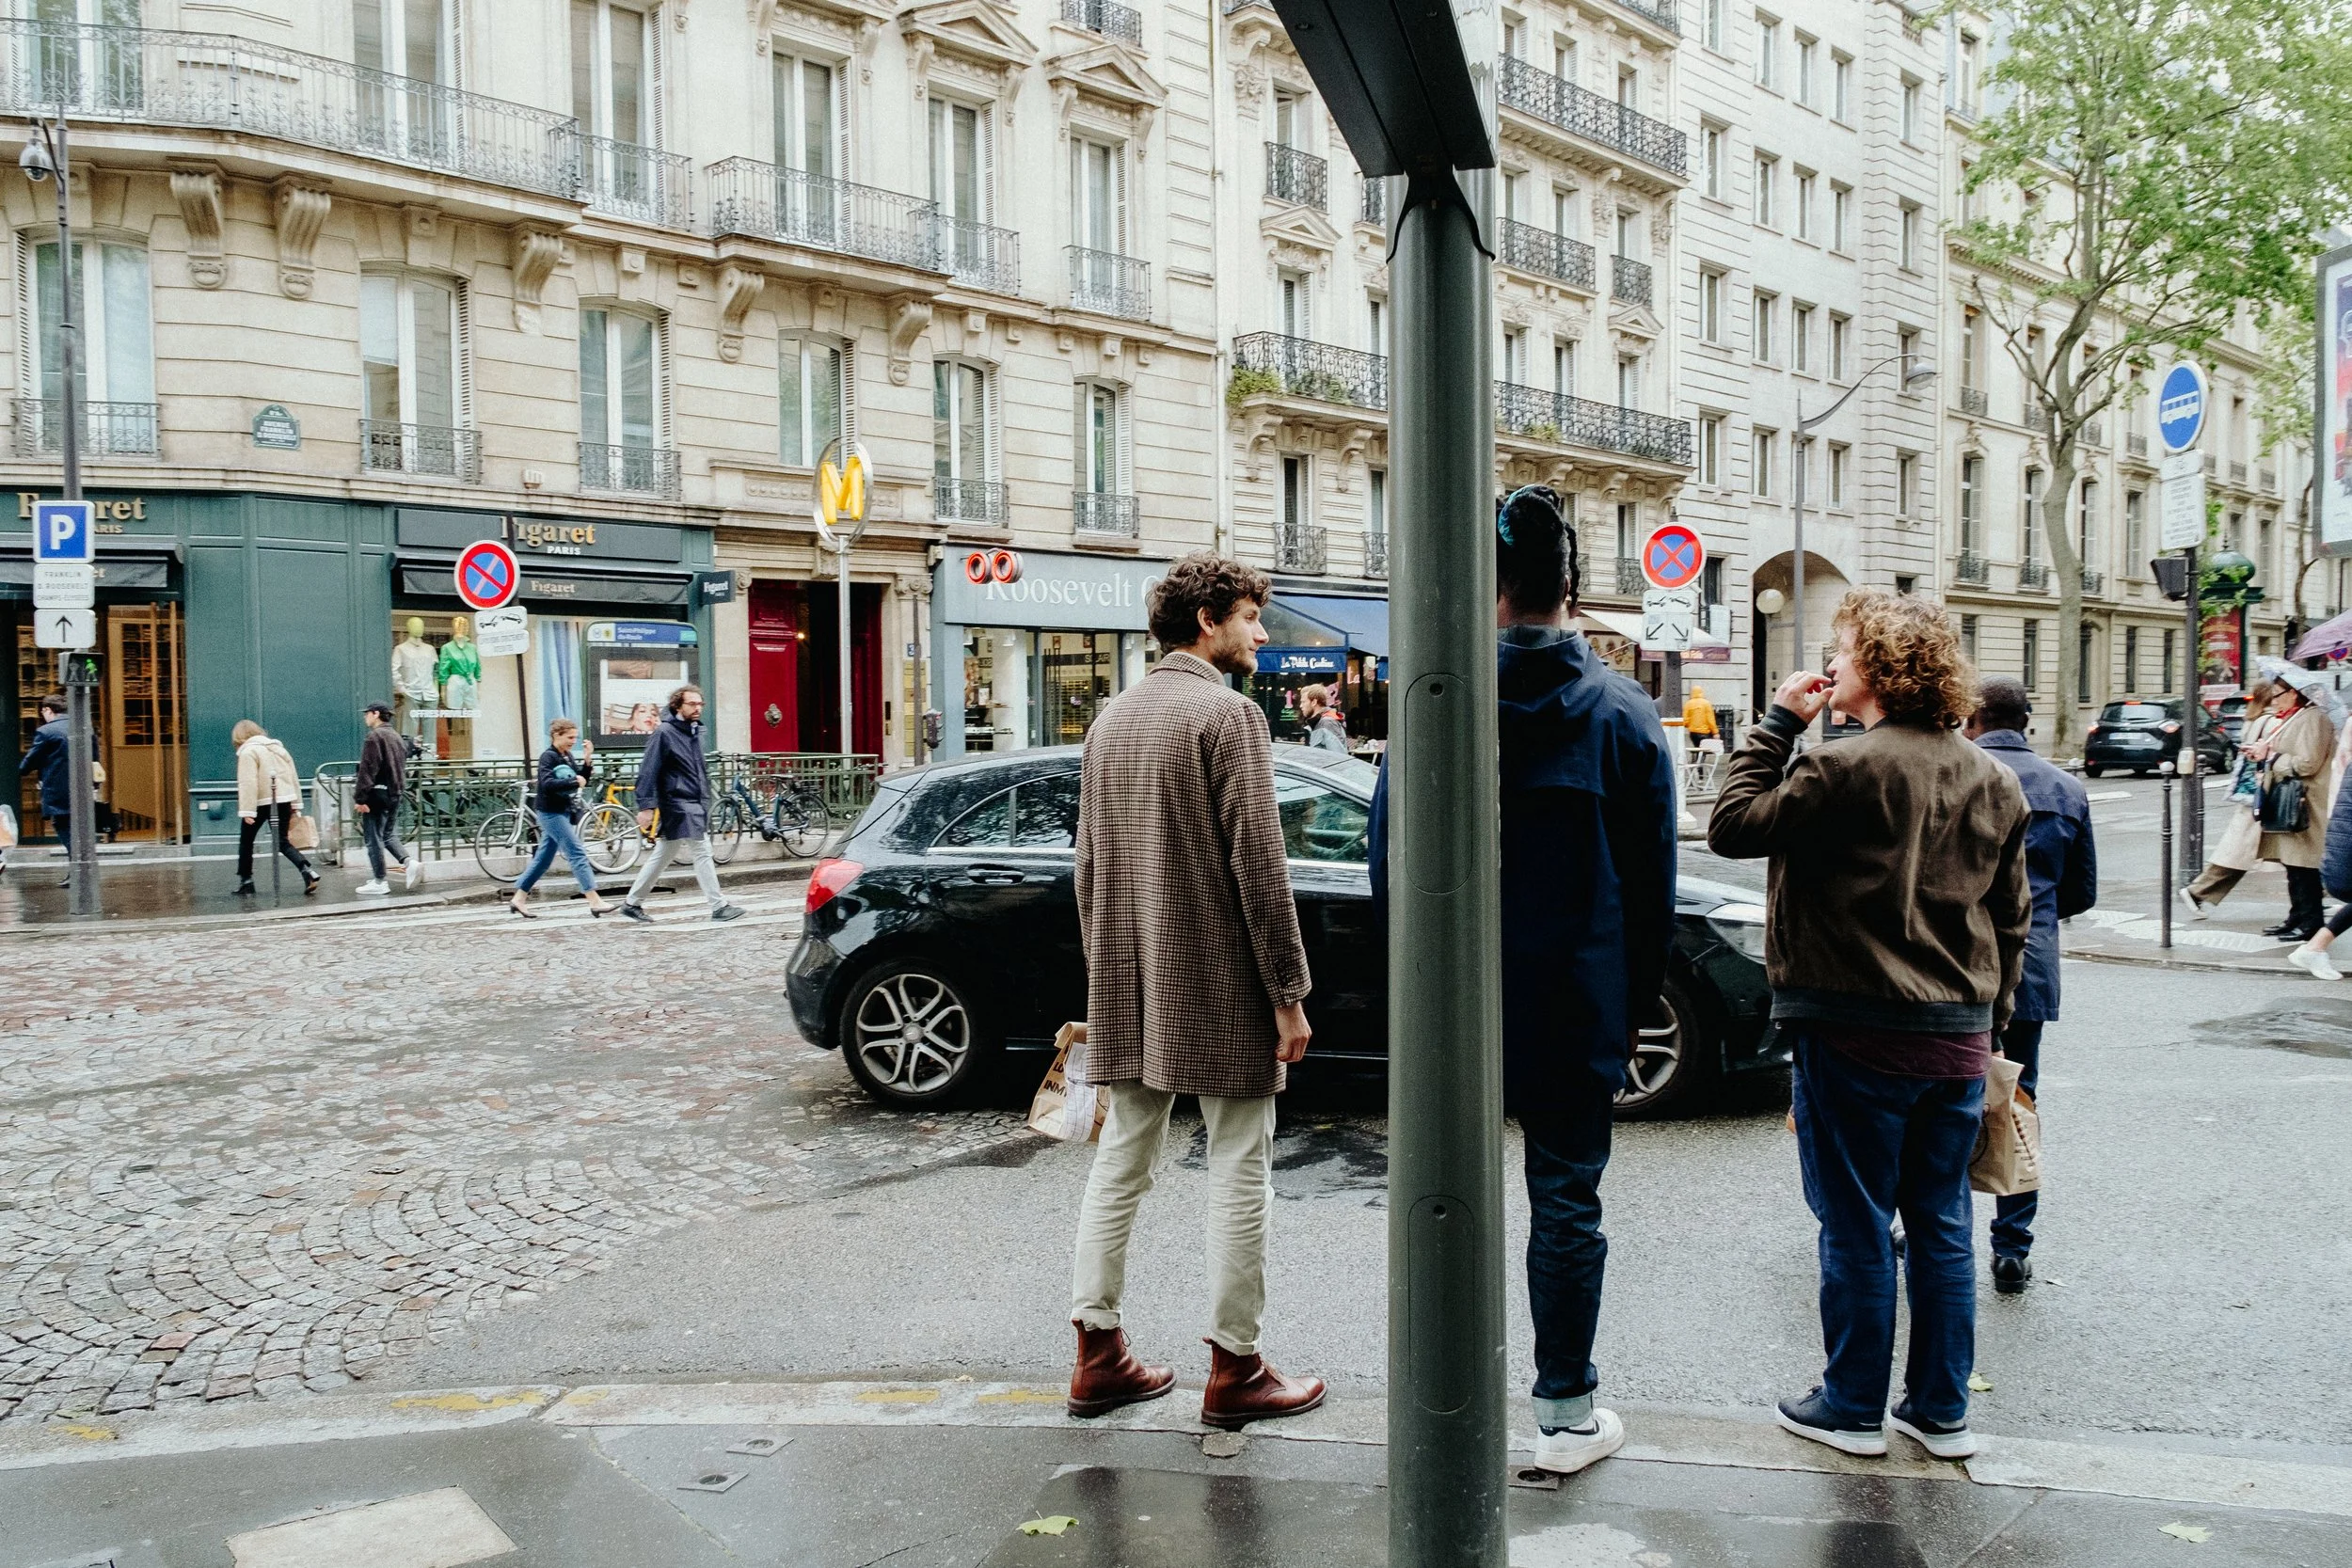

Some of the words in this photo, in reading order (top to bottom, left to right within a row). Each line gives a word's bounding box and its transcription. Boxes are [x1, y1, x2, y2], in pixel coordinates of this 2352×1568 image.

[820, 455, 864, 525] M
[50, 514, 76, 550] P
[547, 546, 581, 555] PARIS
[531, 580, 576, 594] Figaret
